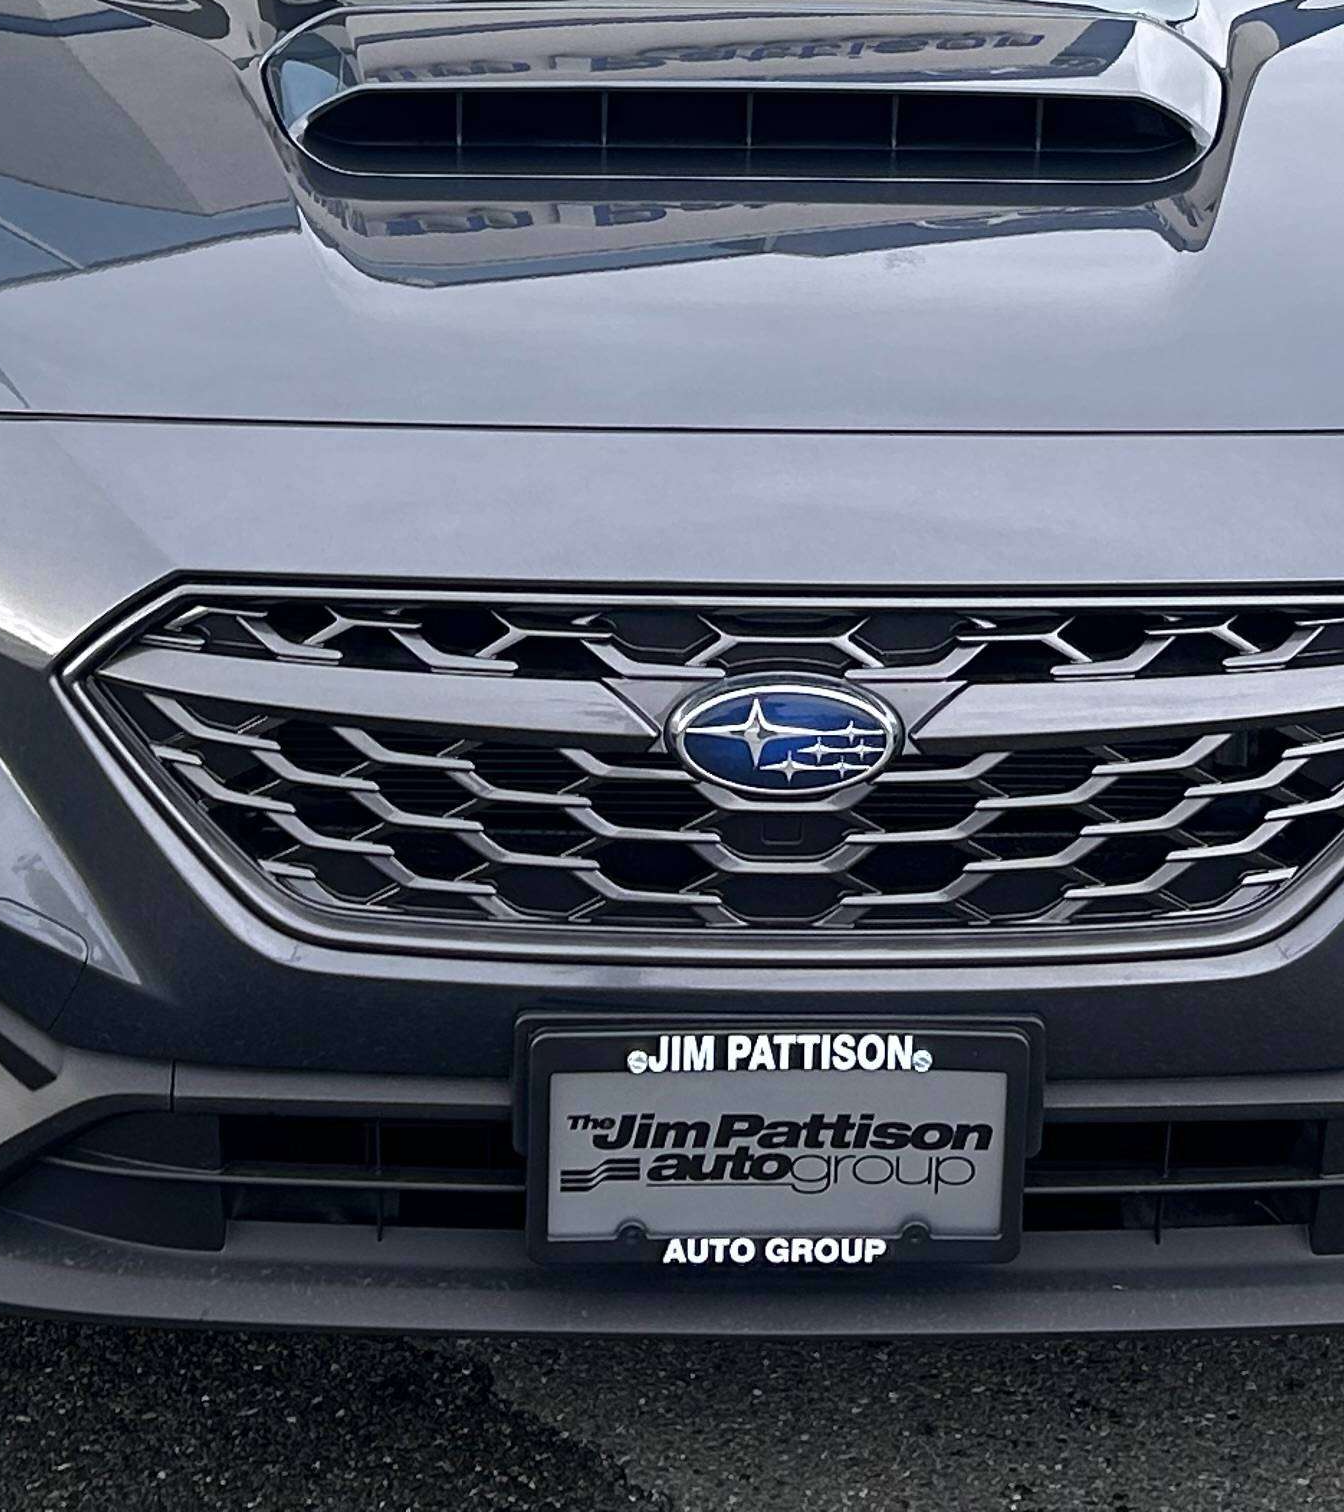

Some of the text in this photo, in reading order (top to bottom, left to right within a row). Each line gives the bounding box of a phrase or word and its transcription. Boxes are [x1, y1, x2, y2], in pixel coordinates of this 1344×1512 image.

[647, 1034, 914, 1072] JIM PATTISON
[566, 1113, 616, 1131] The
[662, 1238, 887, 1264] AUTO GROUP
